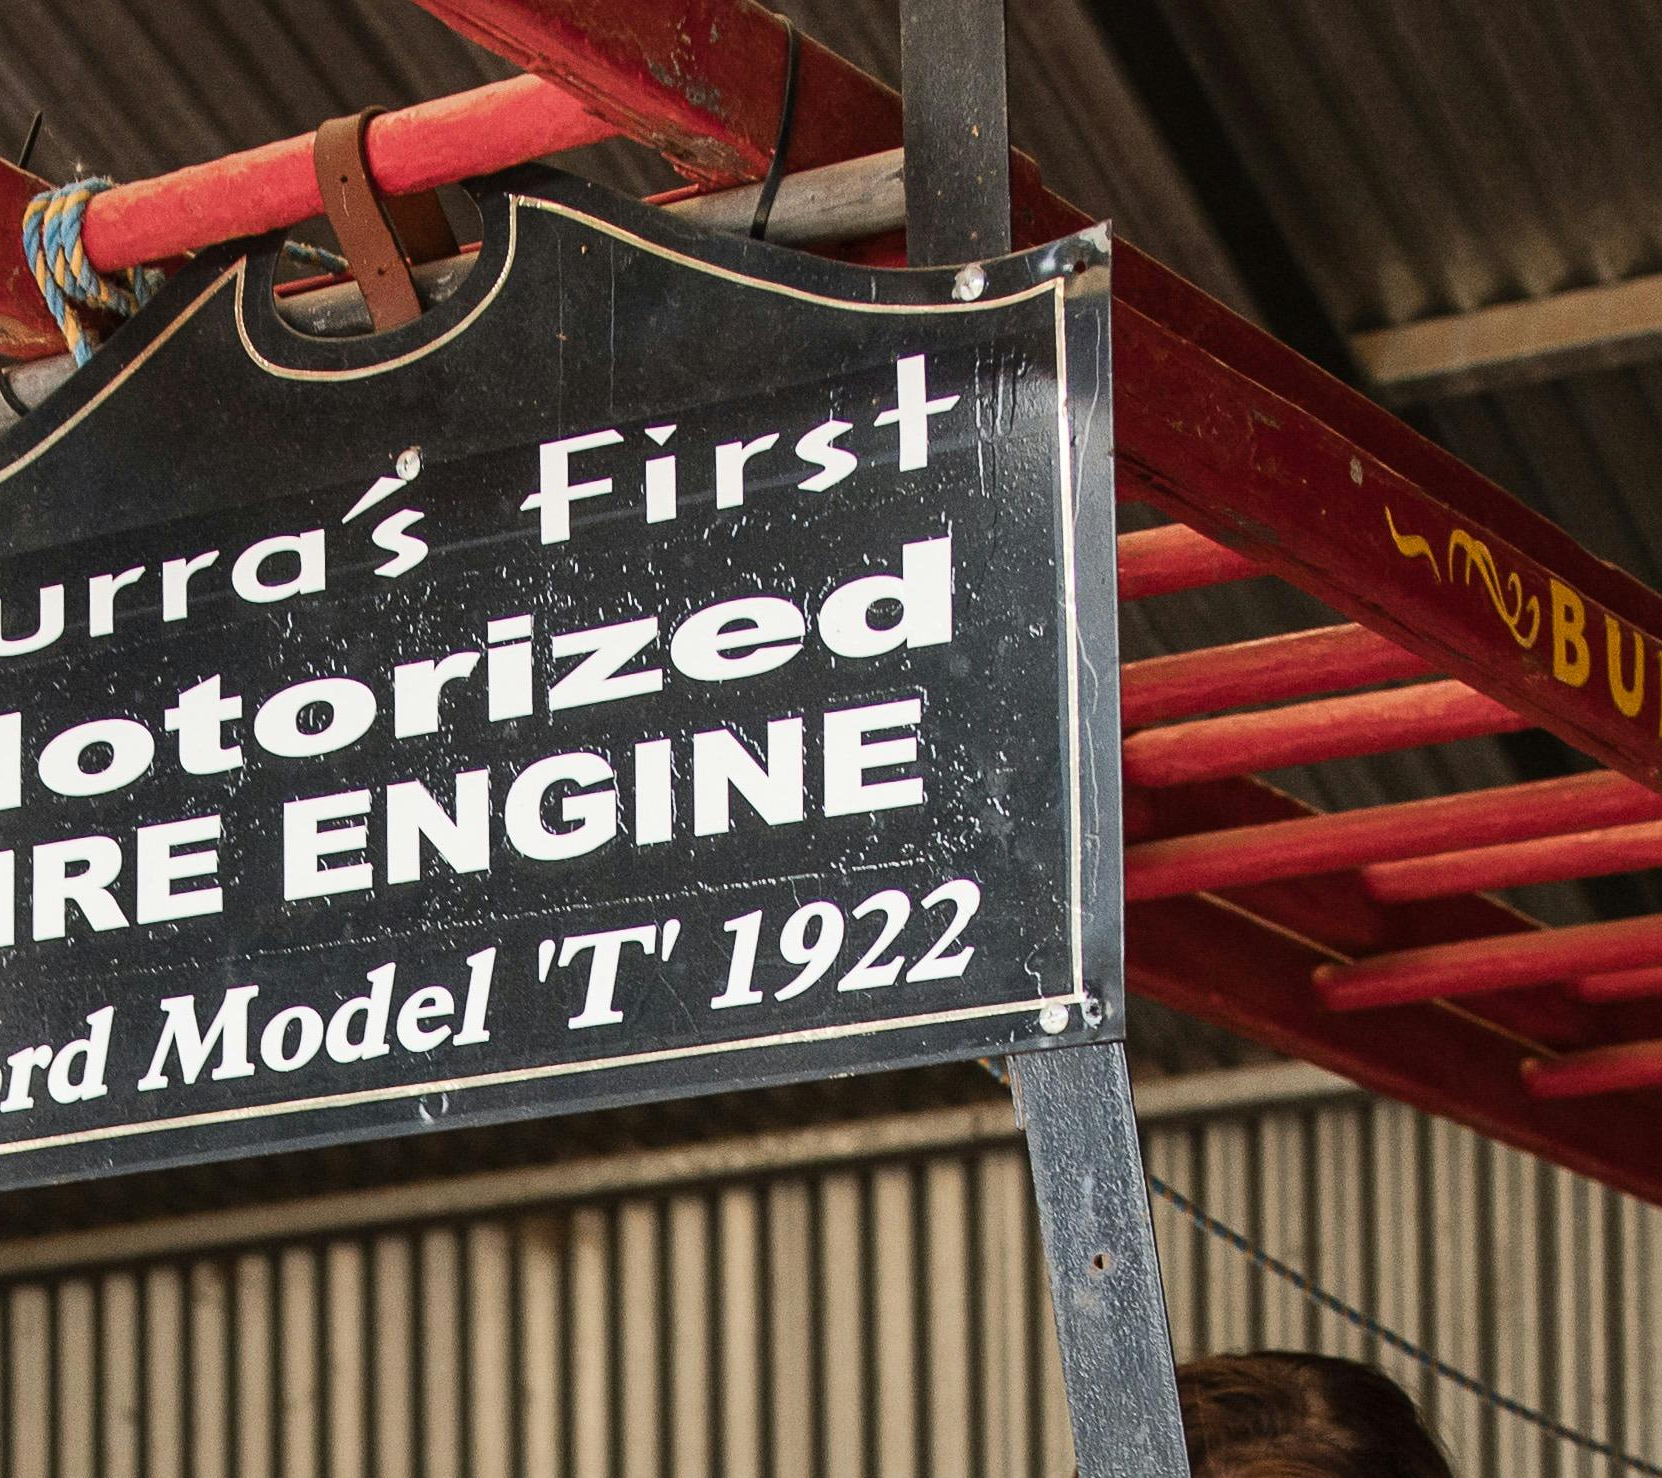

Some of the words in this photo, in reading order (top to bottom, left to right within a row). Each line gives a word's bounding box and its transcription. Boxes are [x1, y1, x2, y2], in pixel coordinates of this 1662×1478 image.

[518, 353, 963, 547] First
[282, 698, 925, 902] ENGINE
[137, 947, 498, 1093] Model
[536, 920, 679, 1031] 'T'
[710, 879, 982, 1011] 1922
